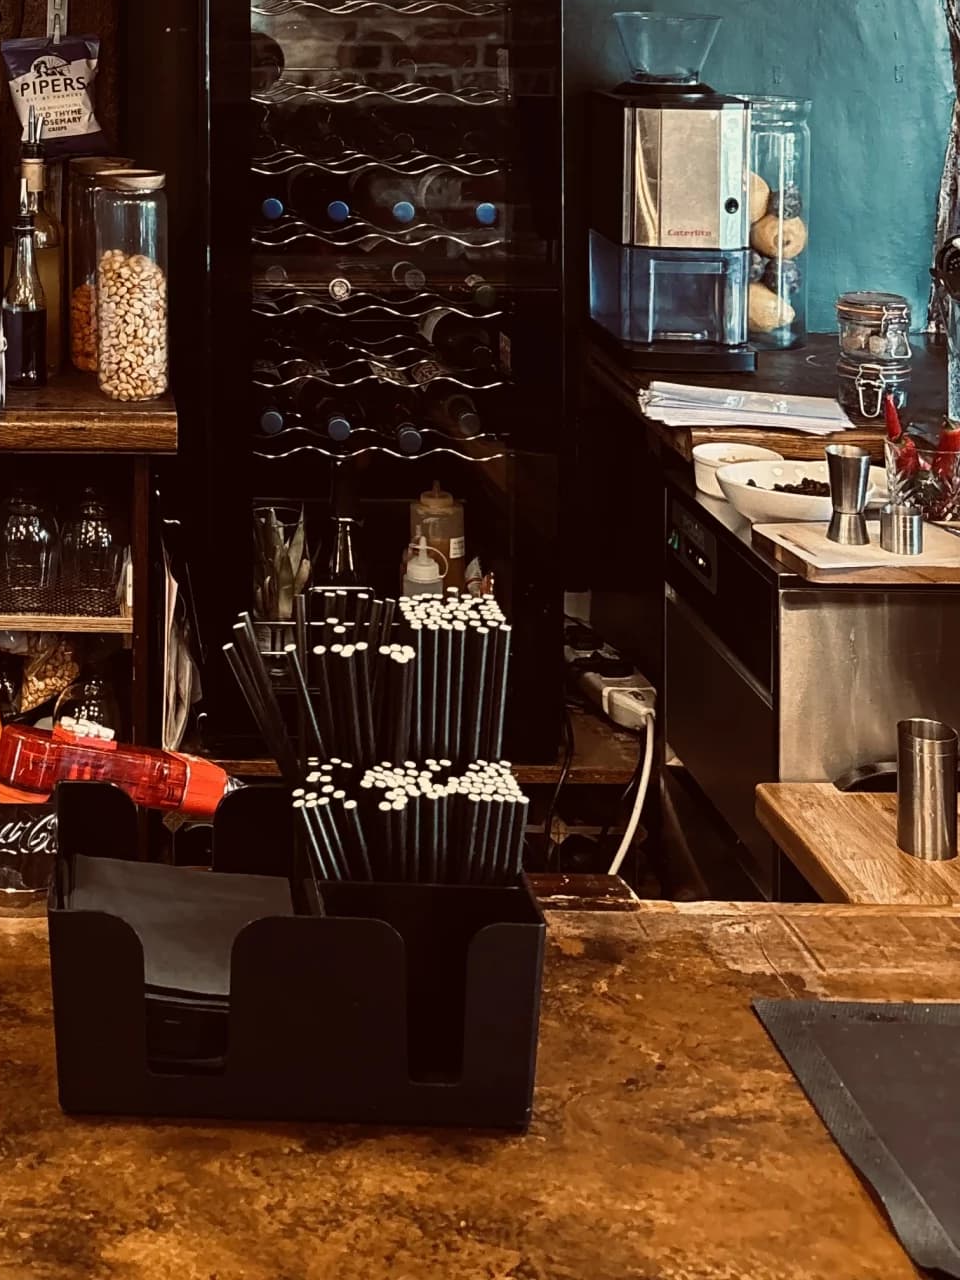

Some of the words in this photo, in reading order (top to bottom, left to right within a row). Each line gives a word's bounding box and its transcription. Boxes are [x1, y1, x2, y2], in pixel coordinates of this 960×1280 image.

[20, 76, 86, 97] PIPERS
[54, 107, 83, 118] THYME
[42, 115, 83, 127] OSEMARY
